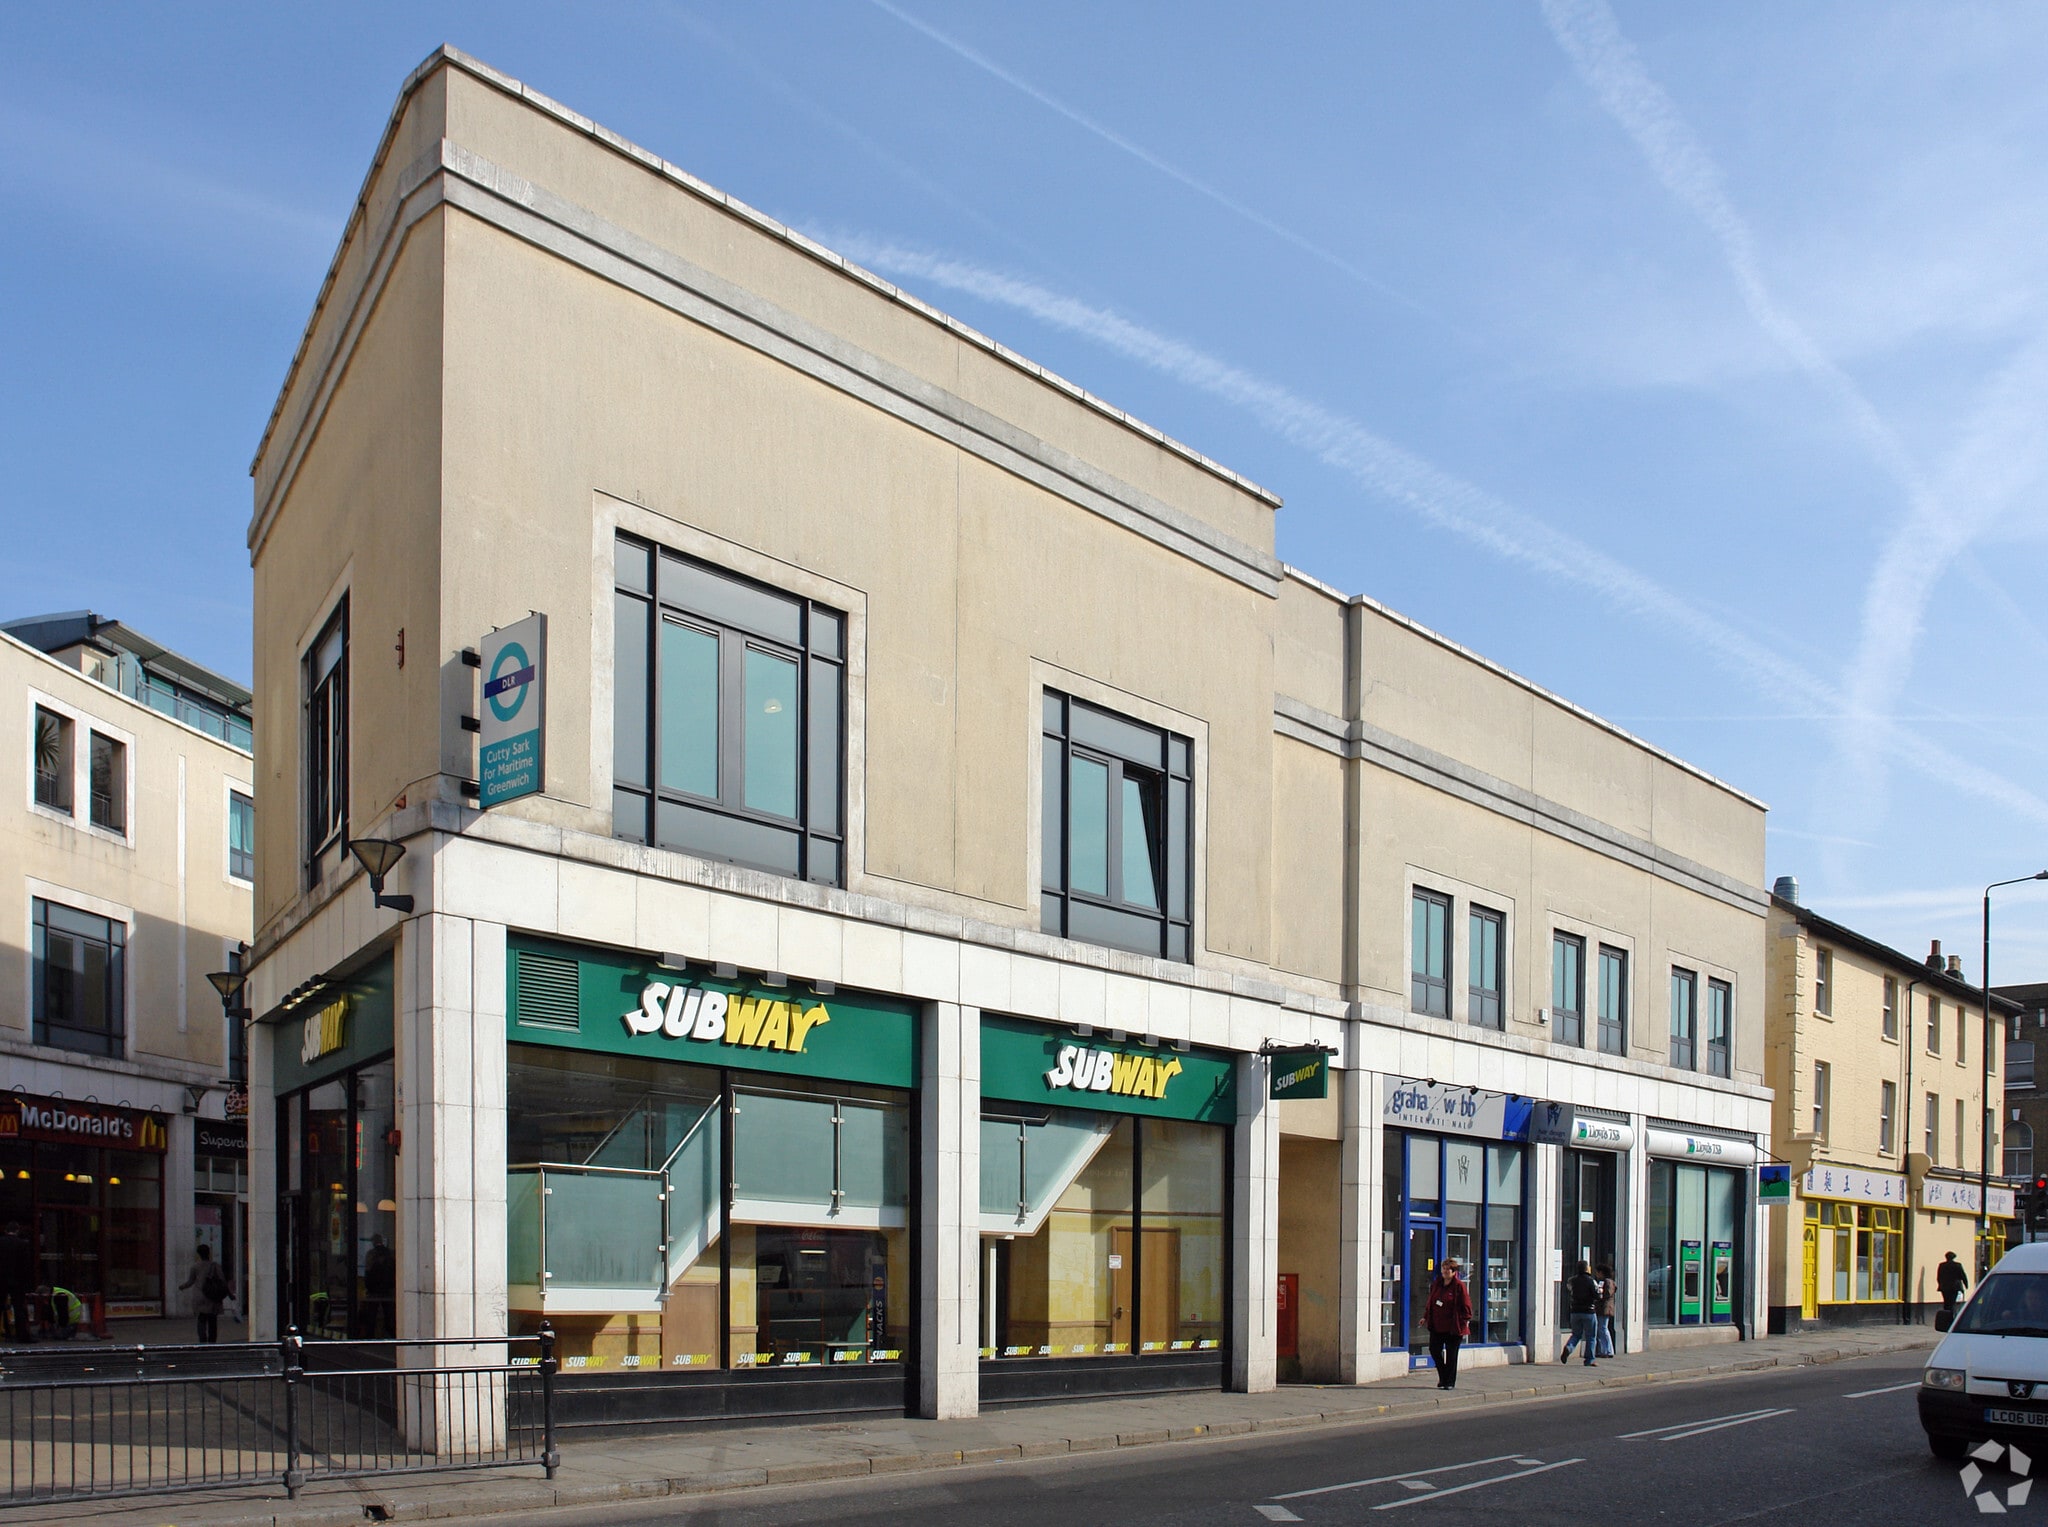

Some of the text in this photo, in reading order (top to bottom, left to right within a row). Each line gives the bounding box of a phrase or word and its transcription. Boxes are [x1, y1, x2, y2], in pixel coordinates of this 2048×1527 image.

[502, 677, 516, 689] DLR
[486, 738, 530, 763] Cutty Sark
[484, 756, 533, 780] for Maritime
[487, 772, 530, 796] Greenwich
[623, 982, 831, 1052] SUBWAY
[301, 993, 349, 1067] SUBWAY
[1046, 1045, 1183, 1098] SUBWAY
[1274, 1061, 1321, 1092] SUBWAY
[1392, 1086, 1477, 1118] graha wbb
[21, 1106, 134, 1138] McDonald's
[1398, 1113, 1467, 1130] INTERNATINAL
[200, 1131, 248, 1149] Superd
[565, 1355, 608, 1368] SUBWAY
[620, 1354, 662, 1367] SUBWAY
[672, 1353, 712, 1365] SUBWAY
[737, 1352, 775, 1364] SUBWAY
[833, 1350, 863, 1361] UBWAY
[870, 1349, 903, 1360] SUBWAY
[1992, 1410, 2025, 1424] LC06
